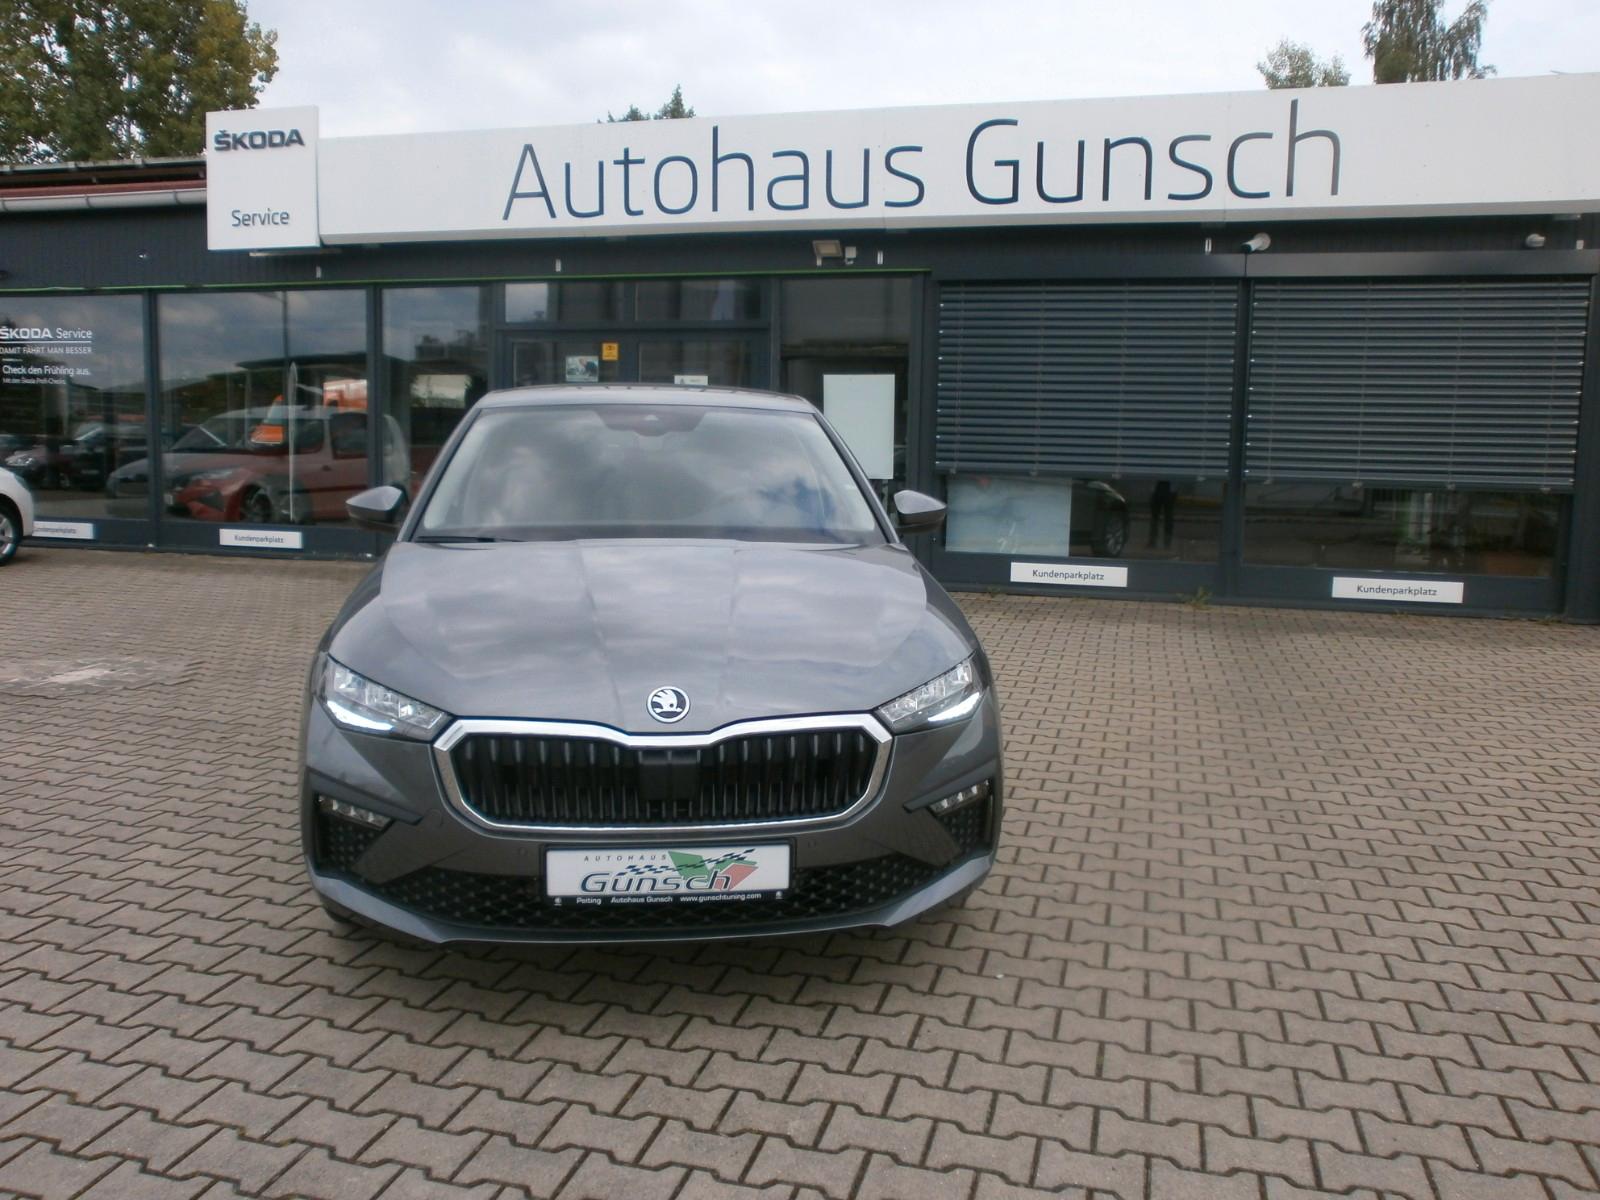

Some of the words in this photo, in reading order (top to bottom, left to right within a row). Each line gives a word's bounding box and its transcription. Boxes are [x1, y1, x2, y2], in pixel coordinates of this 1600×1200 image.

[214, 129, 305, 151] ŠKODA
[502, 125, 925, 221] Autohaus
[966, 98, 1341, 205] Gunsch
[231, 208, 290, 227] Service
[0, 326, 54, 339] ŠKODA
[56, 328, 93, 339] Service
[47, 346, 64, 354] MAN
[65, 346, 92, 354] BESSER
[2, 365, 26, 375] Check
[27, 365, 42, 375] den
[44, 365, 74, 377] Frühling
[1032, 569, 1105, 582] Kundenparkplatz
[1356, 585, 1438, 597] Kundenparkplatz
[611, 896, 645, 904] Autohaus
[646, 896, 673, 904] Gunsch
[680, 893, 762, 903] www.gunschtuning.com
